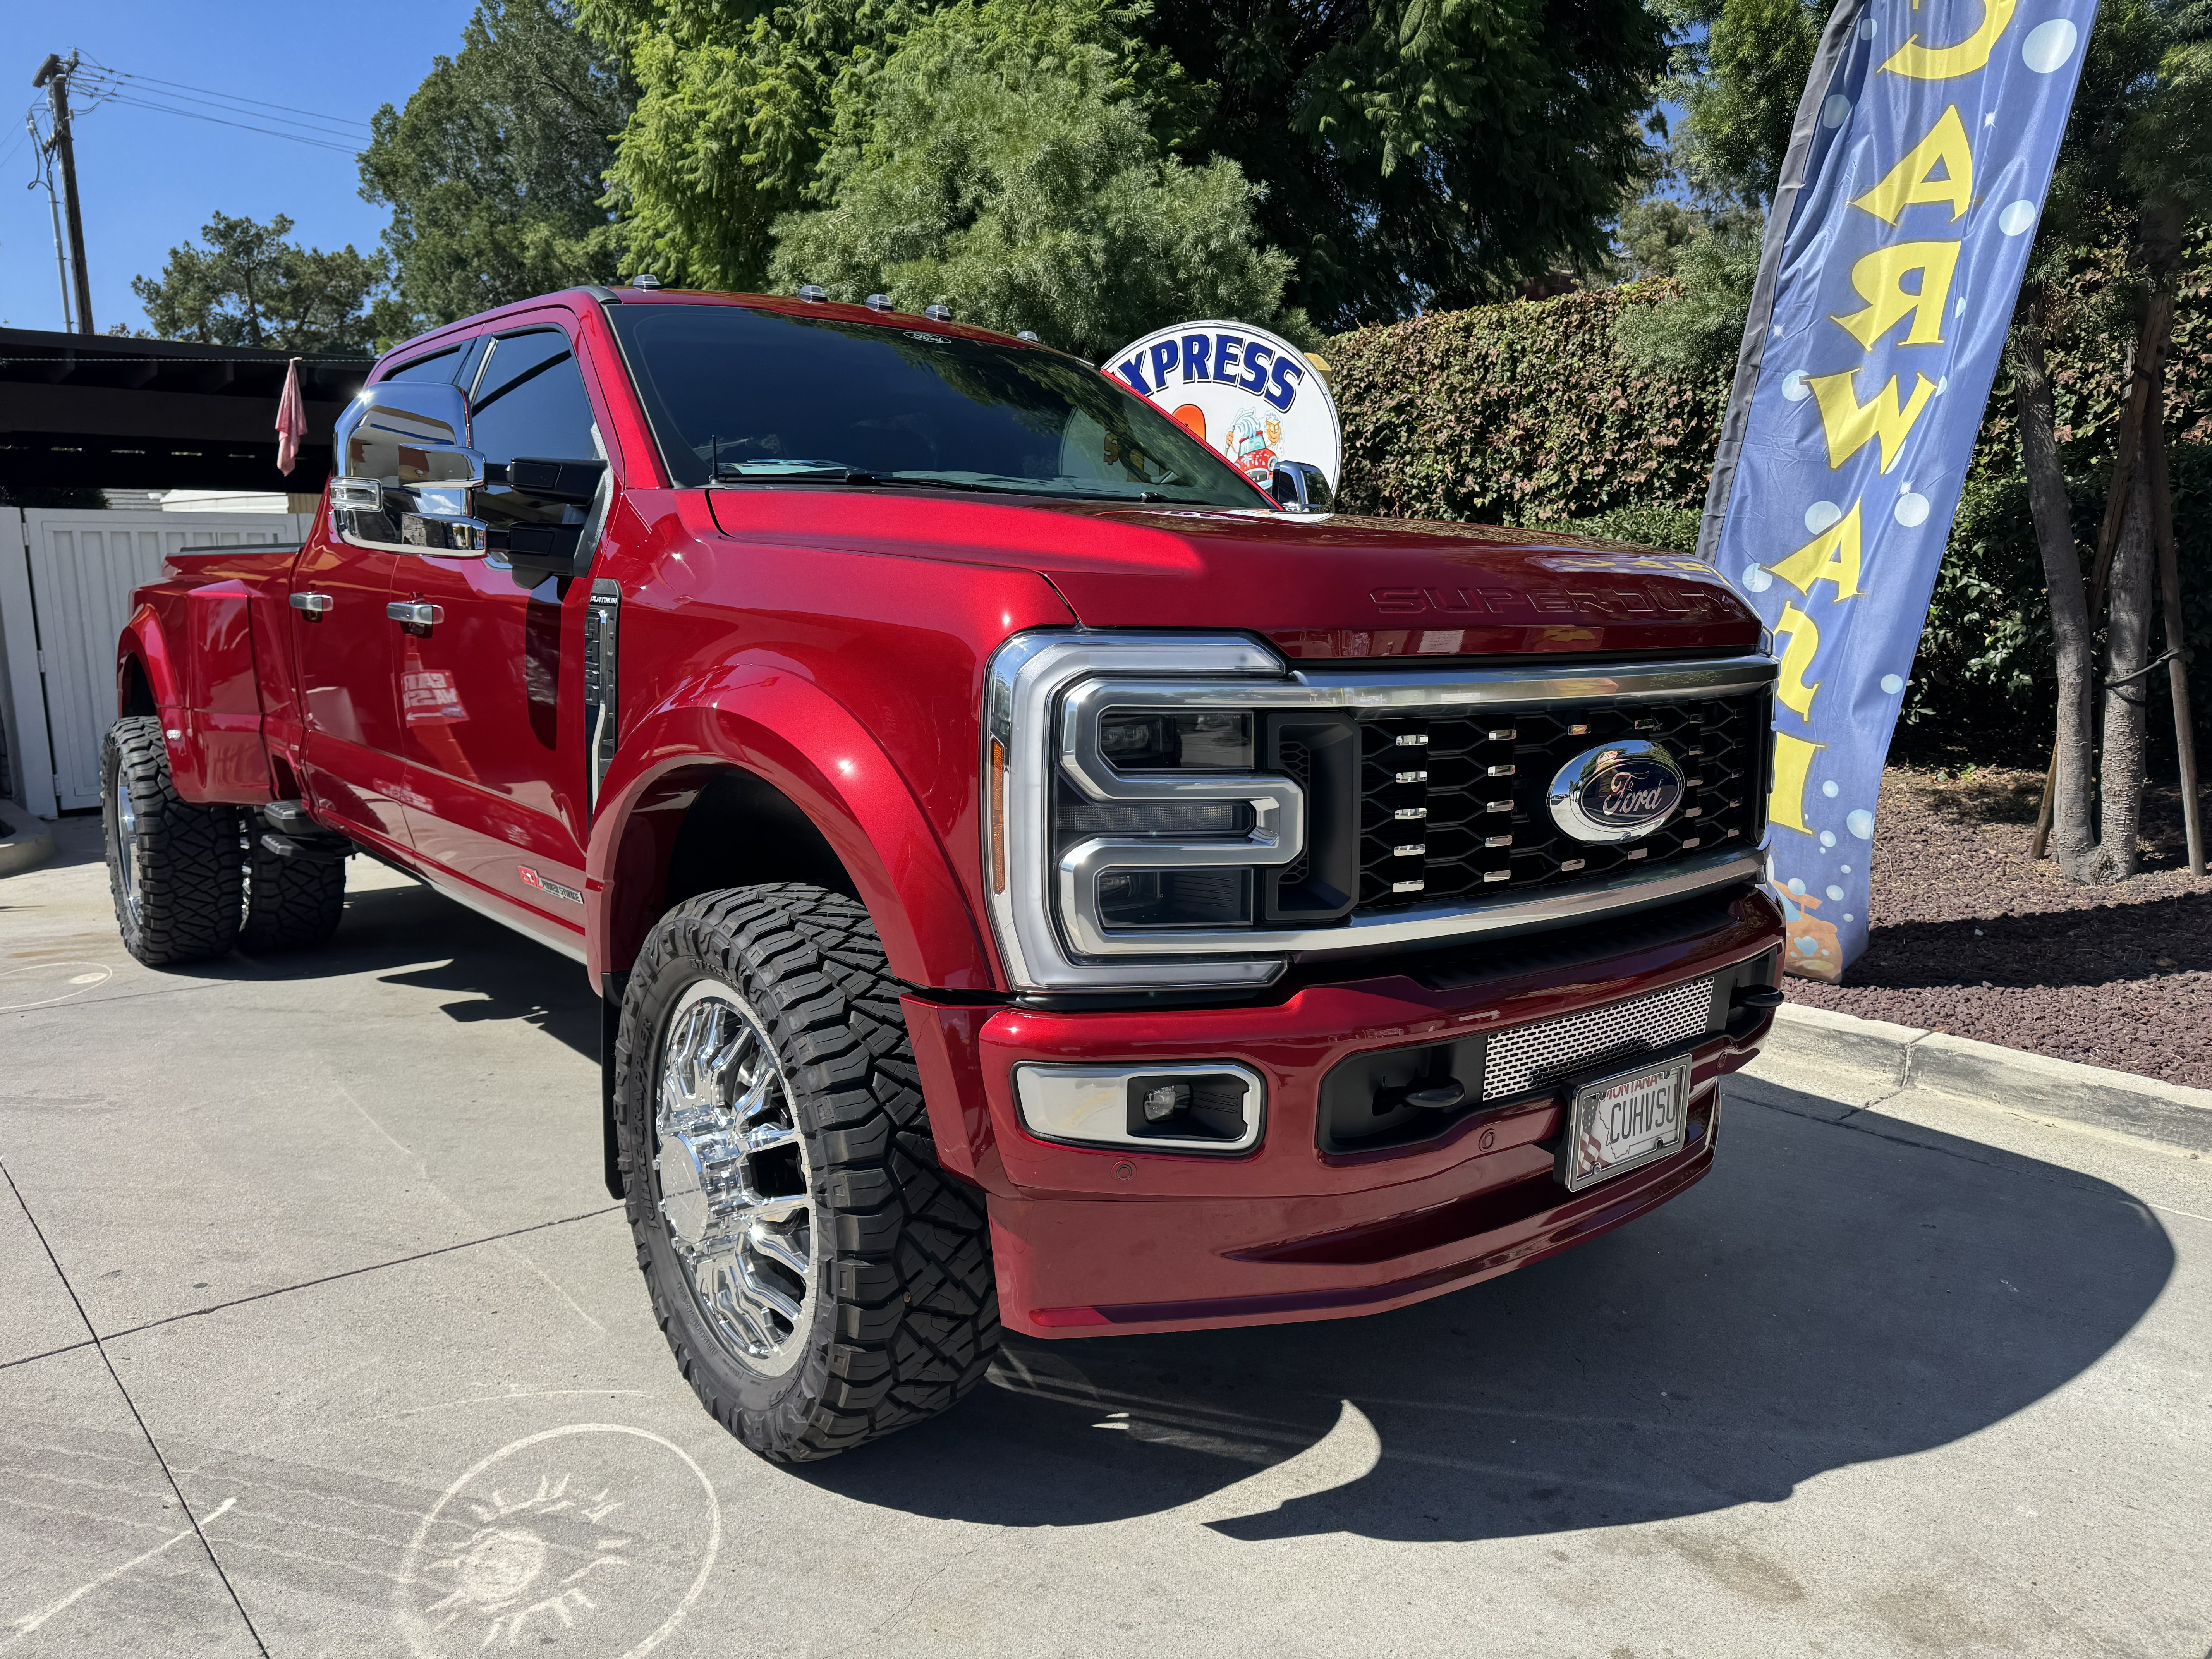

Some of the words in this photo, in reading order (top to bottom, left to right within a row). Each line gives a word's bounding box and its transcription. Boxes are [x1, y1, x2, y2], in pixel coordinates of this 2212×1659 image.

[913, 332, 944, 343] Ford
[1116, 333, 1305, 413] XPRESS
[1370, 587, 1614, 614] SUPER
[1609, 585, 1731, 613] DUTY
[1602, 770, 1664, 816] Ford
[1610, 1083, 1677, 1144] CUHVSU
